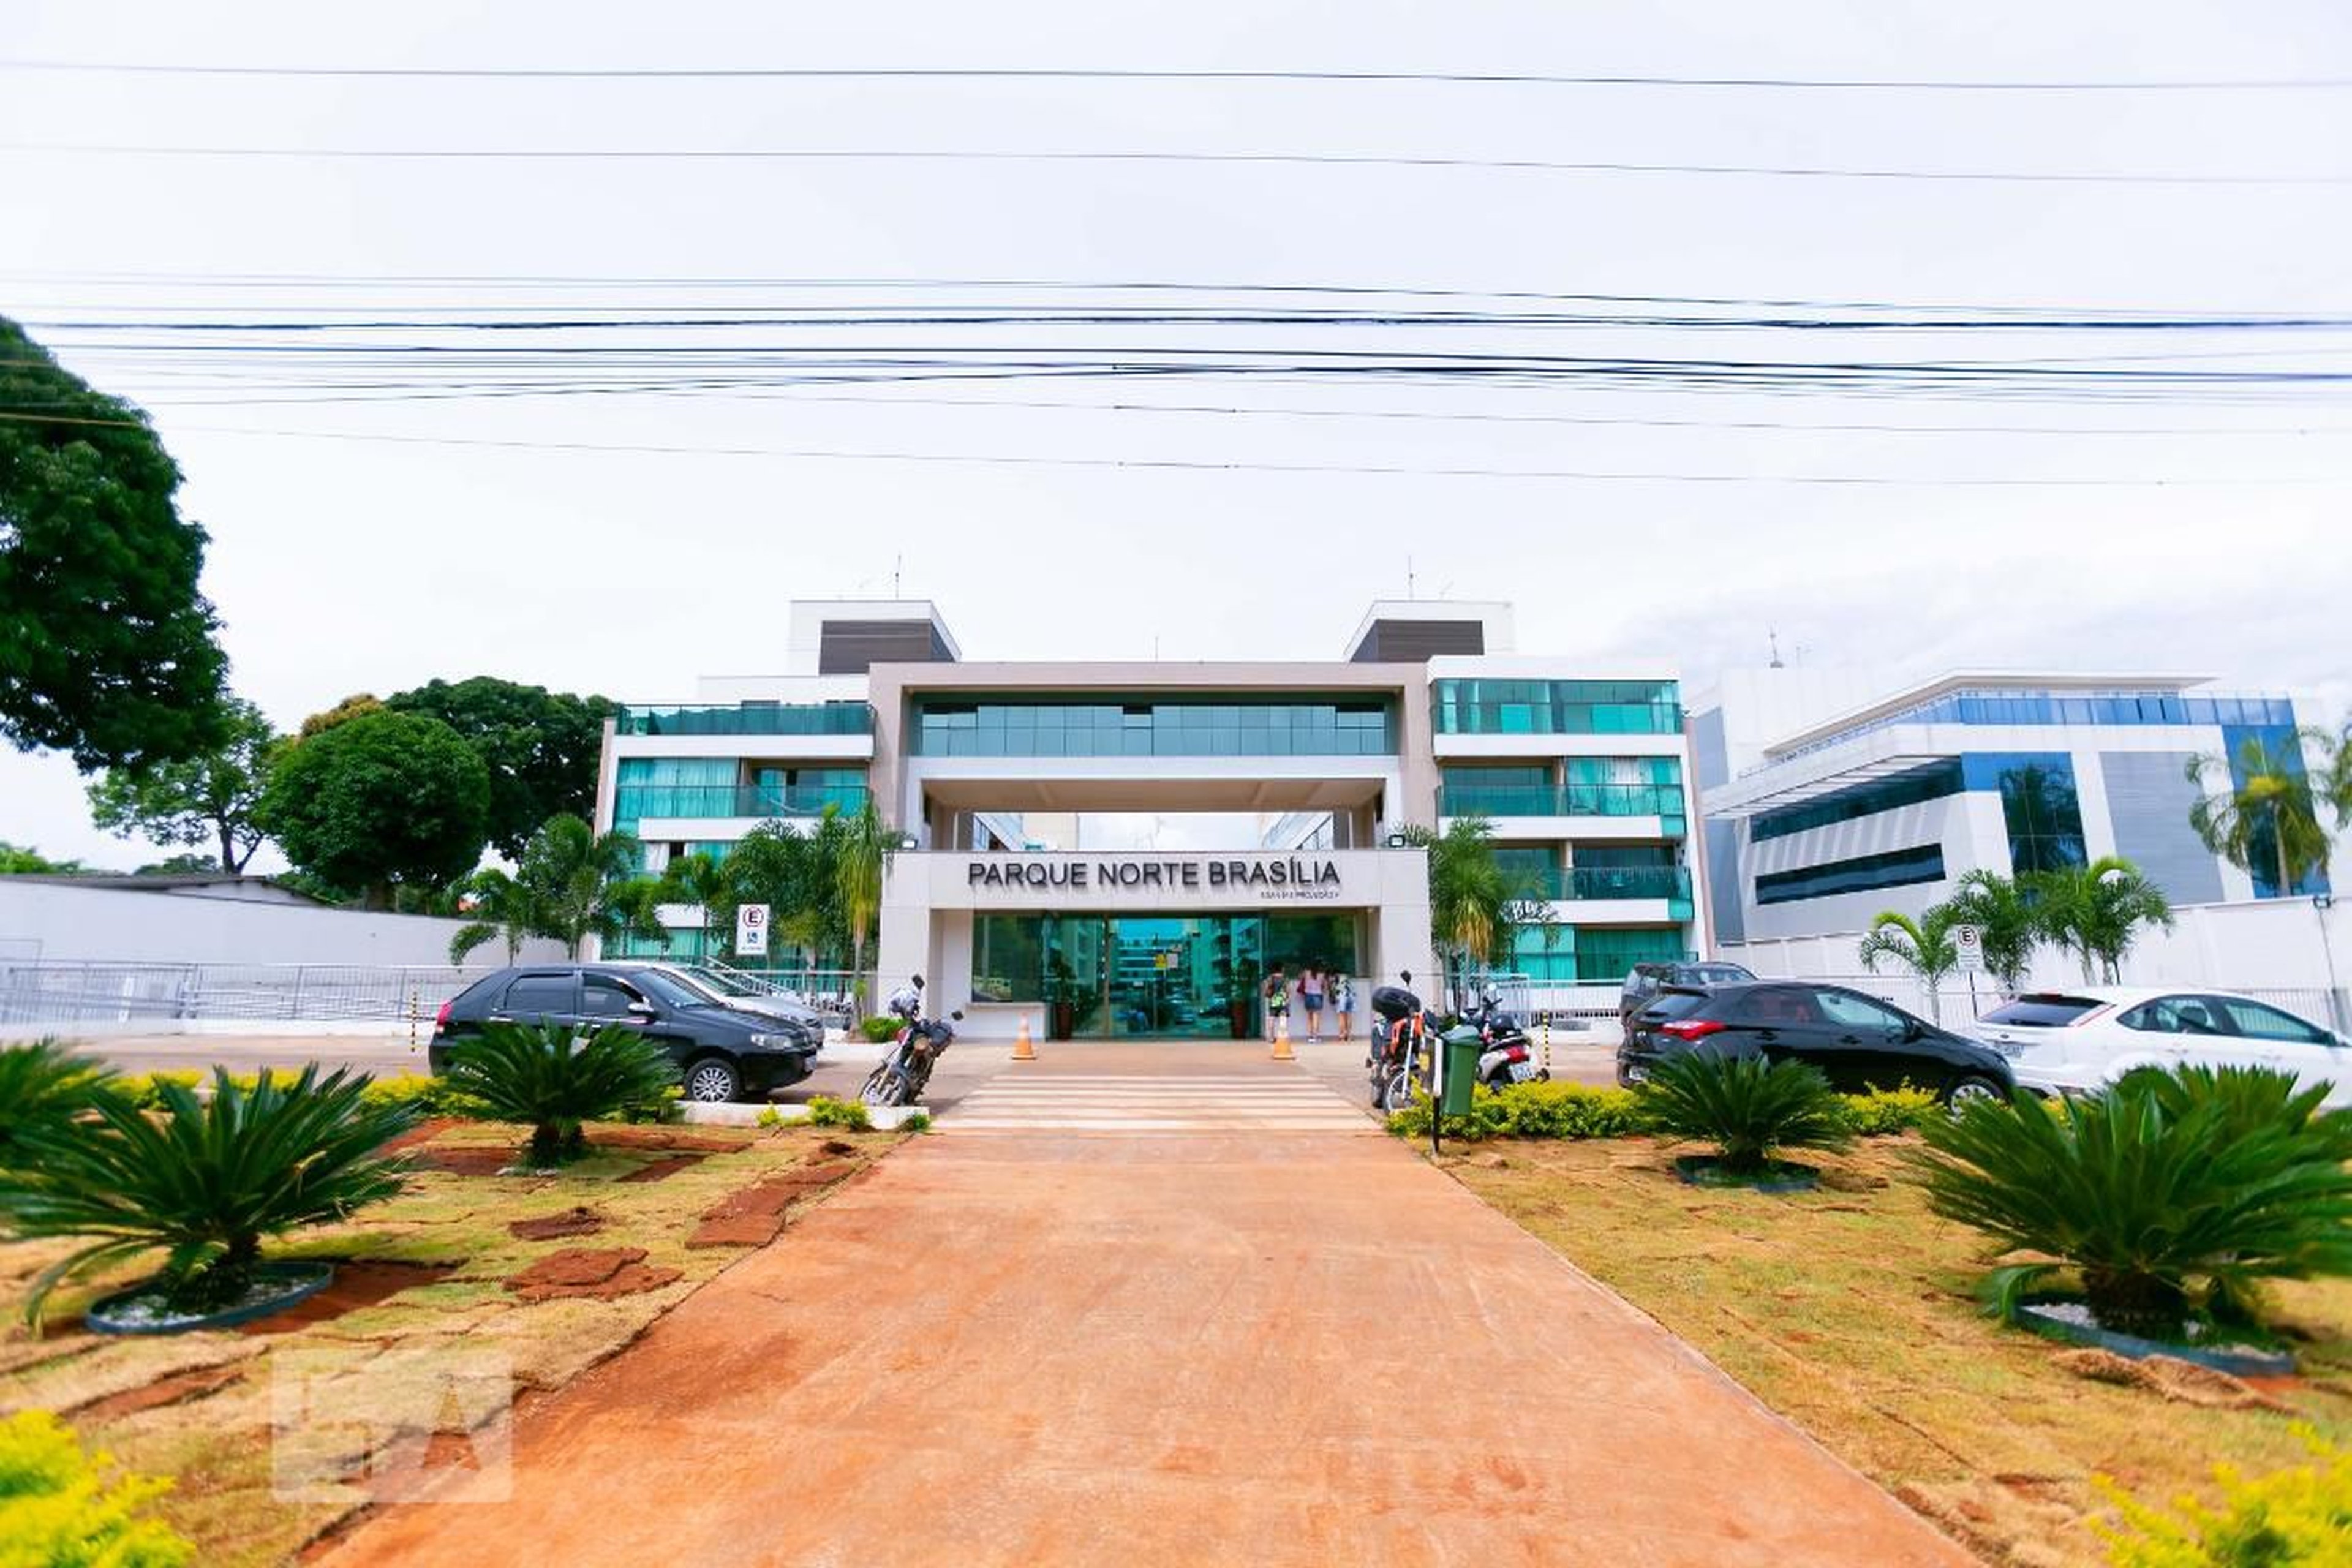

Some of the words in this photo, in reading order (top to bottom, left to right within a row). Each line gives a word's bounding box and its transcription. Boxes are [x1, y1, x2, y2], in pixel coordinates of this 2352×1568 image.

[968, 862, 1088, 887] PARQUE
[1098, 862, 1199, 886] NORTE
[1208, 856, 1341, 886] BRASÍLIA
[748, 911, 758, 923] E
[1962, 931, 1971, 941] E
